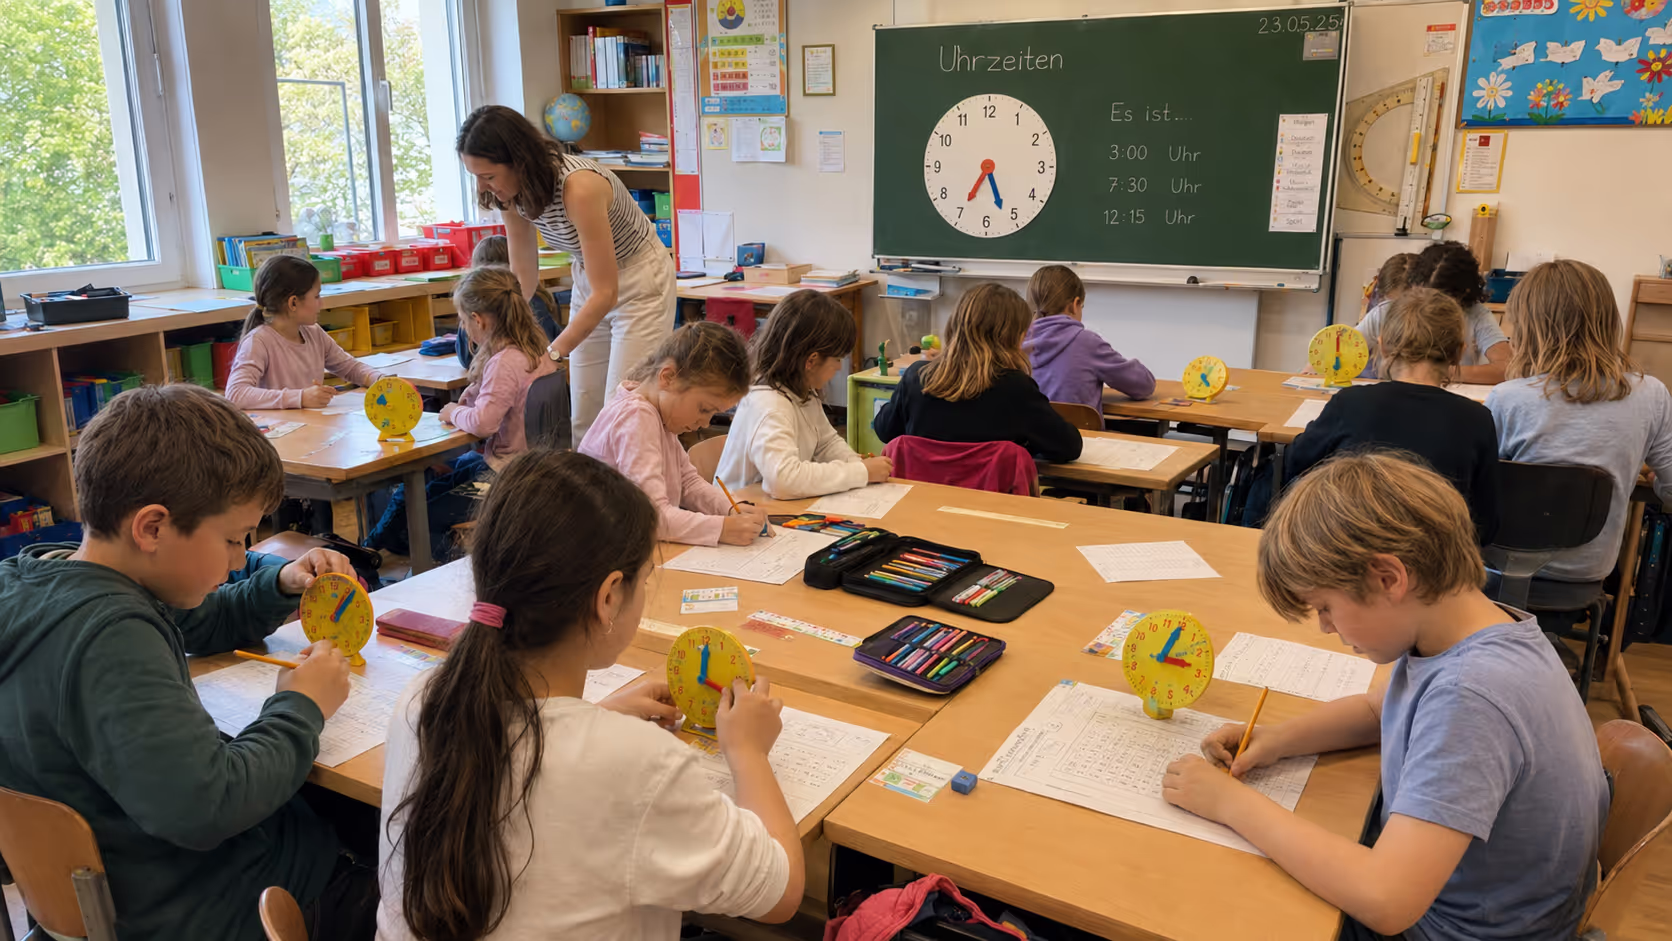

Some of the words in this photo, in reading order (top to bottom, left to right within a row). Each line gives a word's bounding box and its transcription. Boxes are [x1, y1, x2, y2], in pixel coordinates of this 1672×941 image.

[940, 45, 1063, 72] Uhrzeiten
[983, 105, 996, 118] 12
[1111, 102, 1133, 121] Es
[958, 113, 968, 126] 11
[1015, 112, 1020, 126] 1
[939, 134, 952, 147] 10
[1031, 133, 1040, 146] 2
[1109, 144, 1148, 160] 3:00
[1168, 145, 1201, 161] Uhr
[934, 160, 941, 173] 9
[1037, 160, 1045, 174] 3
[1109, 177, 1148, 193] 7:30
[1171, 177, 1202, 194] Uhr
[940, 187, 947, 200] 8
[1028, 187, 1036, 201] 4
[956, 206, 964, 219] 7
[1010, 208, 1018, 220] 5
[1103, 209, 1145, 224] 12:15
[1165, 209, 1195, 225] Uhr
[982, 215, 990, 228] 6
[1149, 622, 1158, 632] 10
[1163, 619, 1172, 628] 11
[688, 639, 695, 649] 11
[720, 641, 724, 651] 1
[677, 650, 686, 660] 10
[1196, 648, 1203, 658] 2
[730, 655, 736, 665] 2
[1194, 669, 1202, 678] 3
